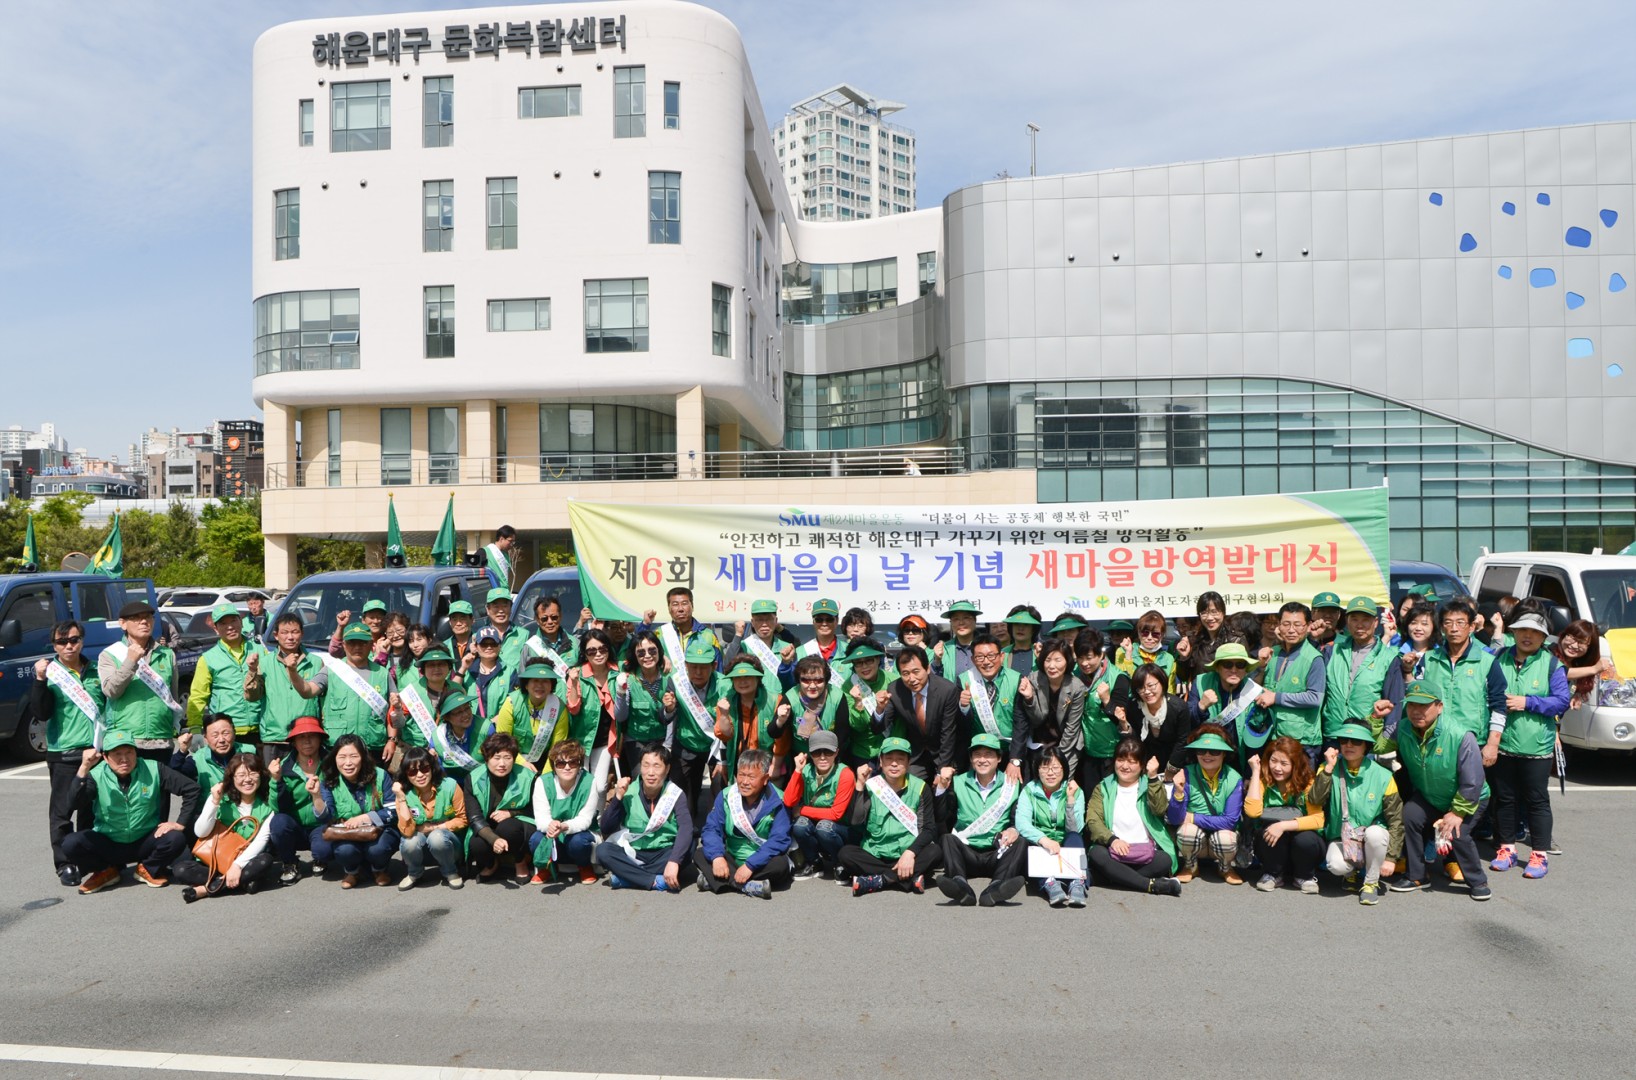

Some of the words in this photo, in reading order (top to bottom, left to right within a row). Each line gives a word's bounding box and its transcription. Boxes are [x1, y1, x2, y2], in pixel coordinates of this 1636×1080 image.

[312, 28, 431, 66] 해운대구
[442, 15, 626, 60] 문화복합센터
[779, 512, 820, 526] SMU
[823, 513, 904, 526] 제2새마을운동
[974, 512, 1000, 524] 사는
[1052, 511, 1091, 523] 행복한
[808, 531, 862, 549] 쾌적한
[868, 530, 940, 548] 해운대구
[948, 530, 1001, 547] 가꾸기
[1009, 530, 1046, 545] 위한
[1053, 529, 1108, 544] 여름철
[609, 554, 695, 591] 제6회
[715, 552, 858, 592] 새마을의
[879, 552, 915, 590] 날
[933, 550, 1003, 590] 기념
[1025, 541, 1338, 590] 새마을방역발대식
[714, 600, 737, 612] 일시
[867, 600, 891, 612] 장소
[907, 599, 981, 612] 문화복터
[1063, 598, 1090, 609] SMU
[1114, 592, 1284, 608] 새마을지도자대구협의회
[480, 628, 495, 637] NY
